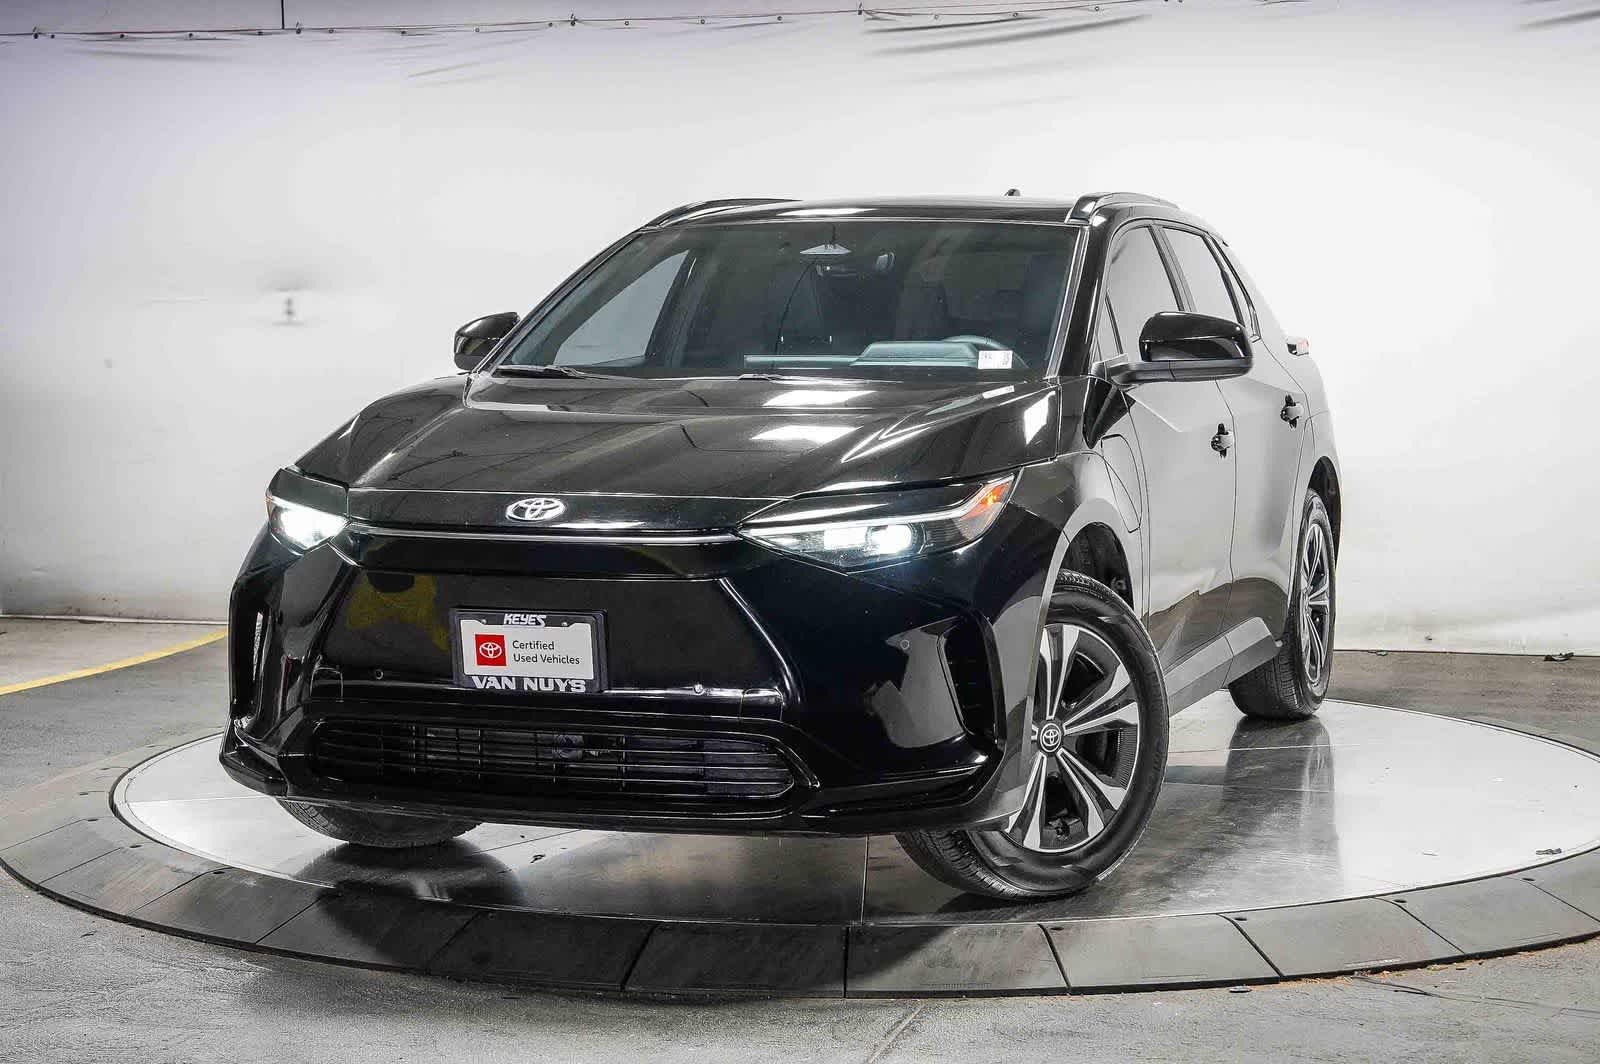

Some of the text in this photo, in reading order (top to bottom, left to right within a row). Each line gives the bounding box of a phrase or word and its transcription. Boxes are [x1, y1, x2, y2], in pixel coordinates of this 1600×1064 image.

[503, 613, 546, 627] KEYES
[512, 640, 554, 650] Certified
[513, 654, 580, 665] Used Vehicles
[471, 676, 586, 693] VAN NUYS
